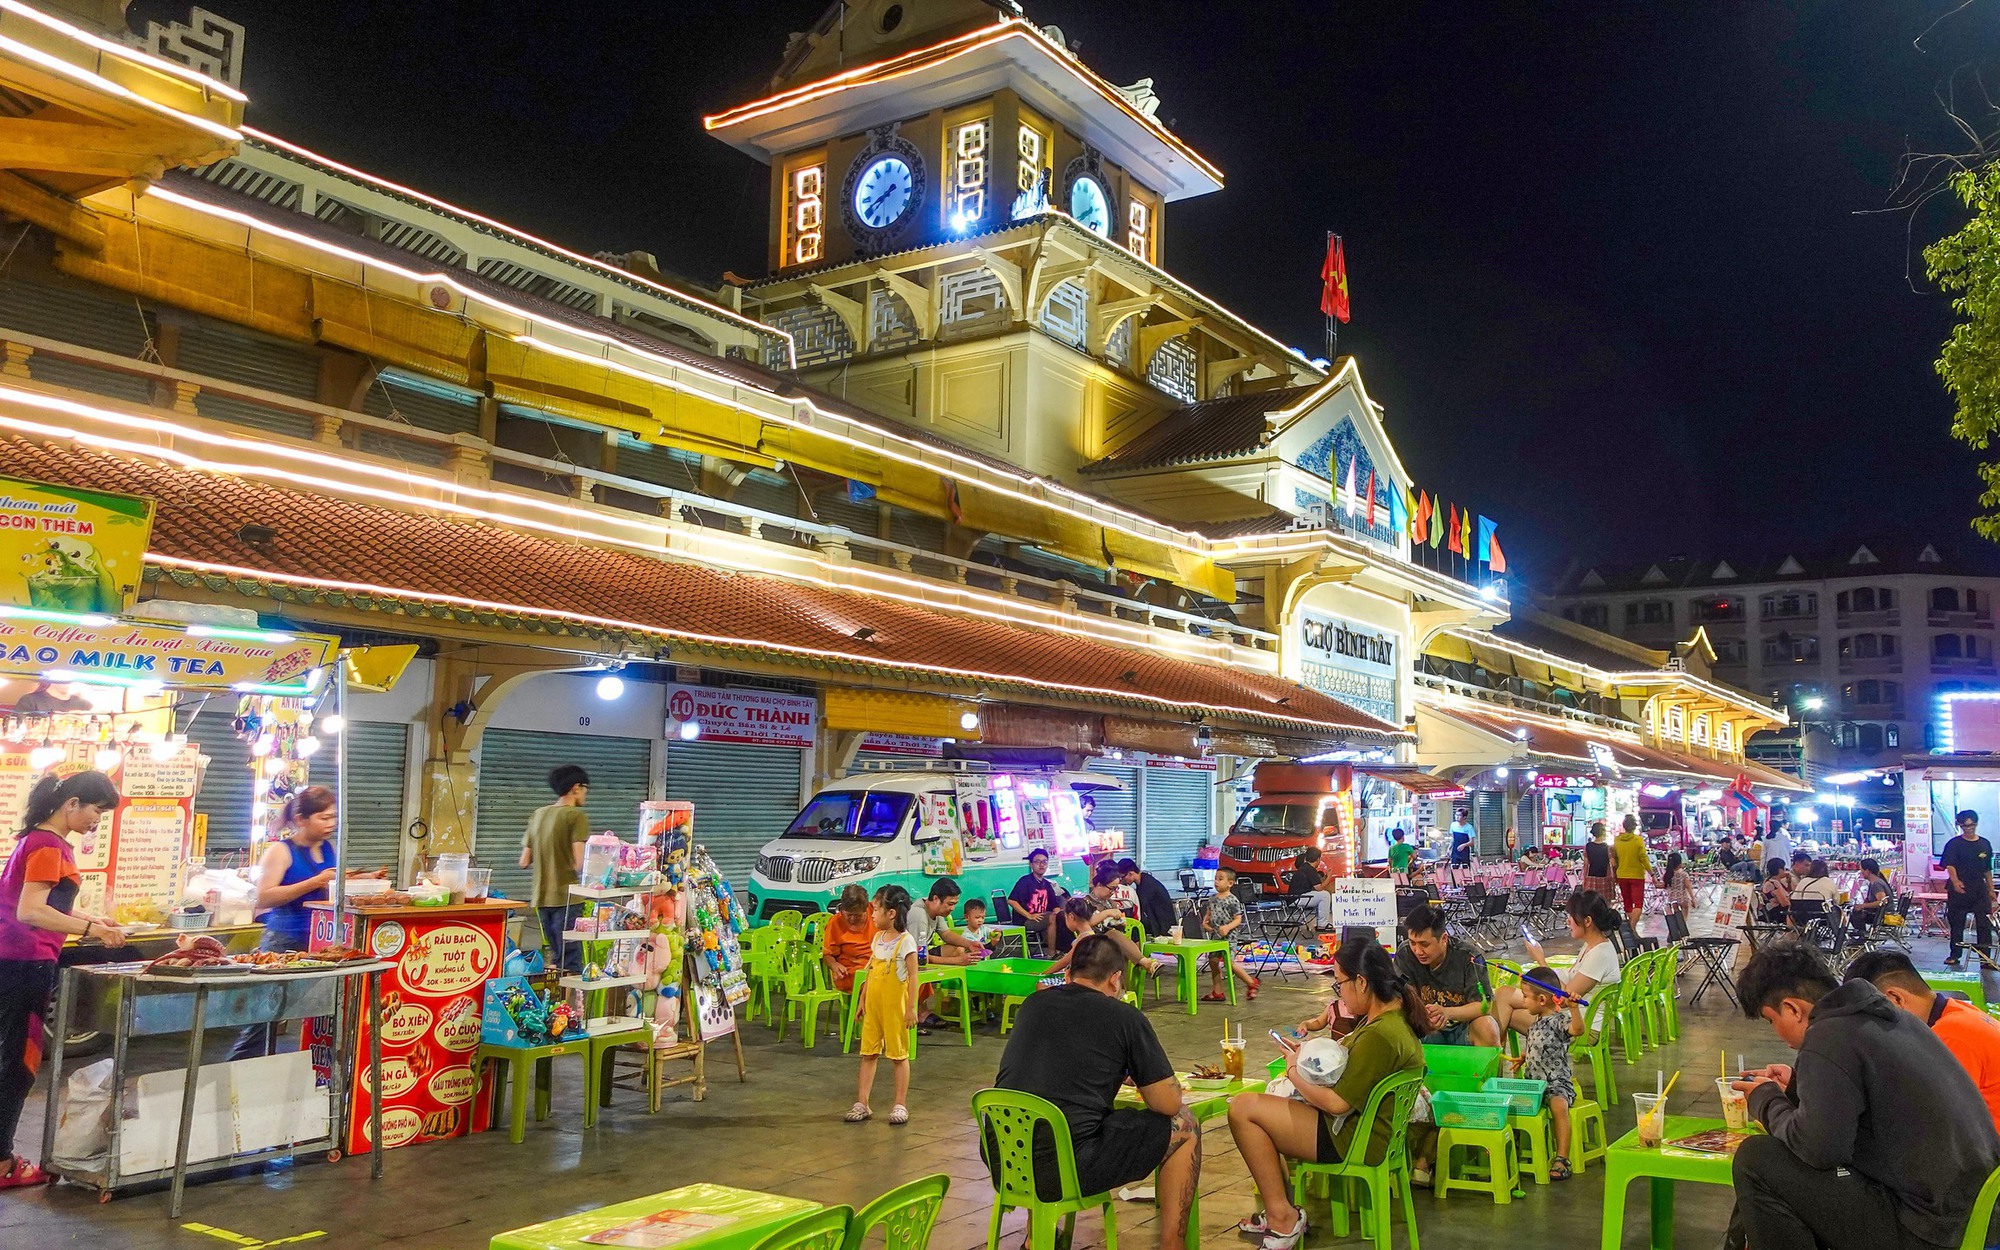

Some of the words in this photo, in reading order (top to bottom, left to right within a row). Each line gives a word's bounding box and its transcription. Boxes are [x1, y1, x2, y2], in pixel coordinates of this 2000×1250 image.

[44, 503, 76, 513] mát
[41, 518, 93, 534] THÈM
[33, 624, 97, 643] Coffee
[197, 639, 241, 655] Xiên
[244, 647, 274, 658] que
[1303, 618, 1333, 659] CHỢ
[1334, 621, 1368, 660] BÌNH
[1369, 632, 1393, 665] TÂY
[69, 650, 156, 671] MILK
[168, 656, 225, 676] TEA
[694, 690, 716, 699] TRUNG
[718, 691, 732, 700] TÂM
[733, 694, 760, 704] THƯƠNG
[672, 698, 691, 716] 10
[696, 702, 738, 720] ĐỨC
[744, 707, 810, 725] THÀNH
[580, 716, 590, 726] 09
[698, 718, 734, 727] Chuyên
[772, 732, 803, 741] Trang
[326, 922, 350, 944] ĐY
[434, 934, 451, 944] RÂU
[454, 934, 477, 946] BẠCH
[443, 949, 466, 963] TUỘT
[393, 1015, 405, 1028] BÒ
[408, 1014, 428, 1026] XIÊN
[444, 1025, 457, 1037] BÒ
[458, 1022, 482, 1038] CUỘN
[395, 1066, 407, 1079] GÀ
